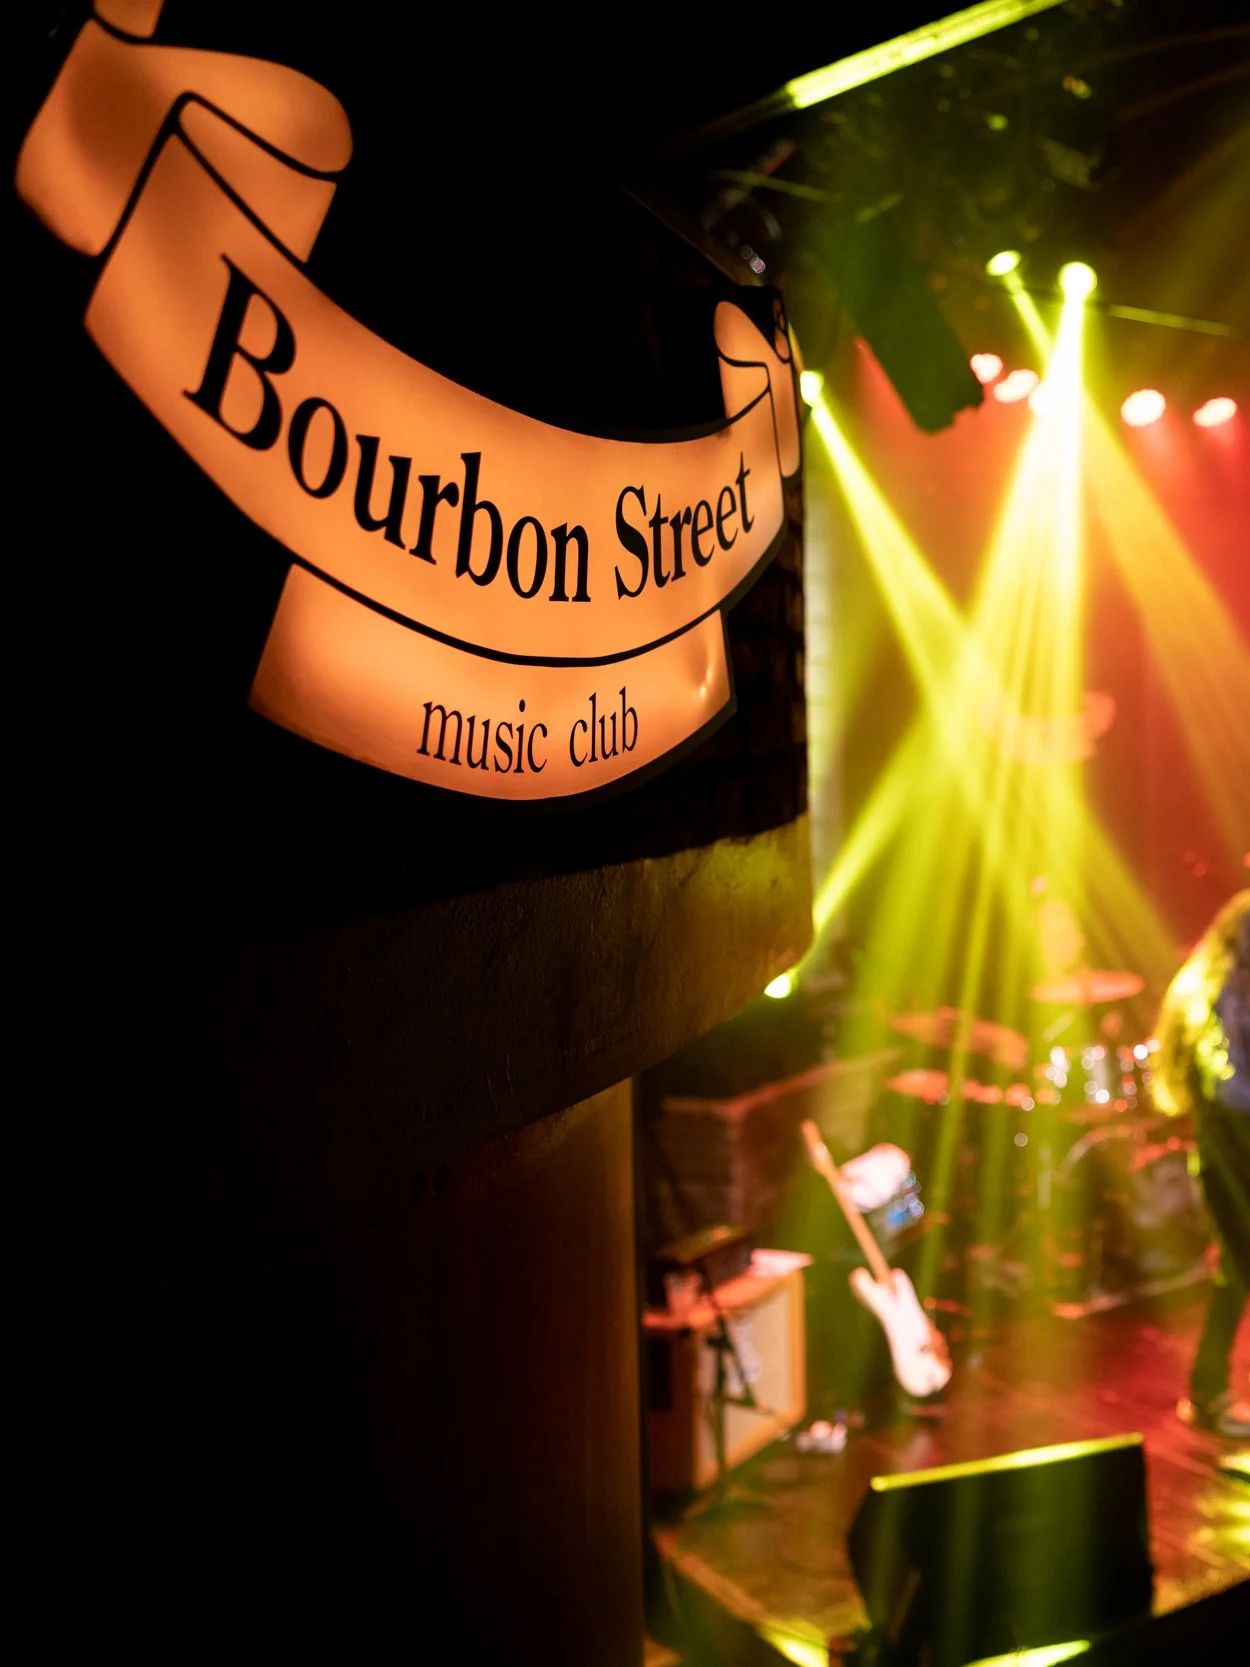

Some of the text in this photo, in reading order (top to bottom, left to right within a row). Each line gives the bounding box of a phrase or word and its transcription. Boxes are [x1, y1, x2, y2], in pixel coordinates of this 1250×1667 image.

[182, 253, 756, 603] Bourbon Street
[417, 687, 639, 774] music club
